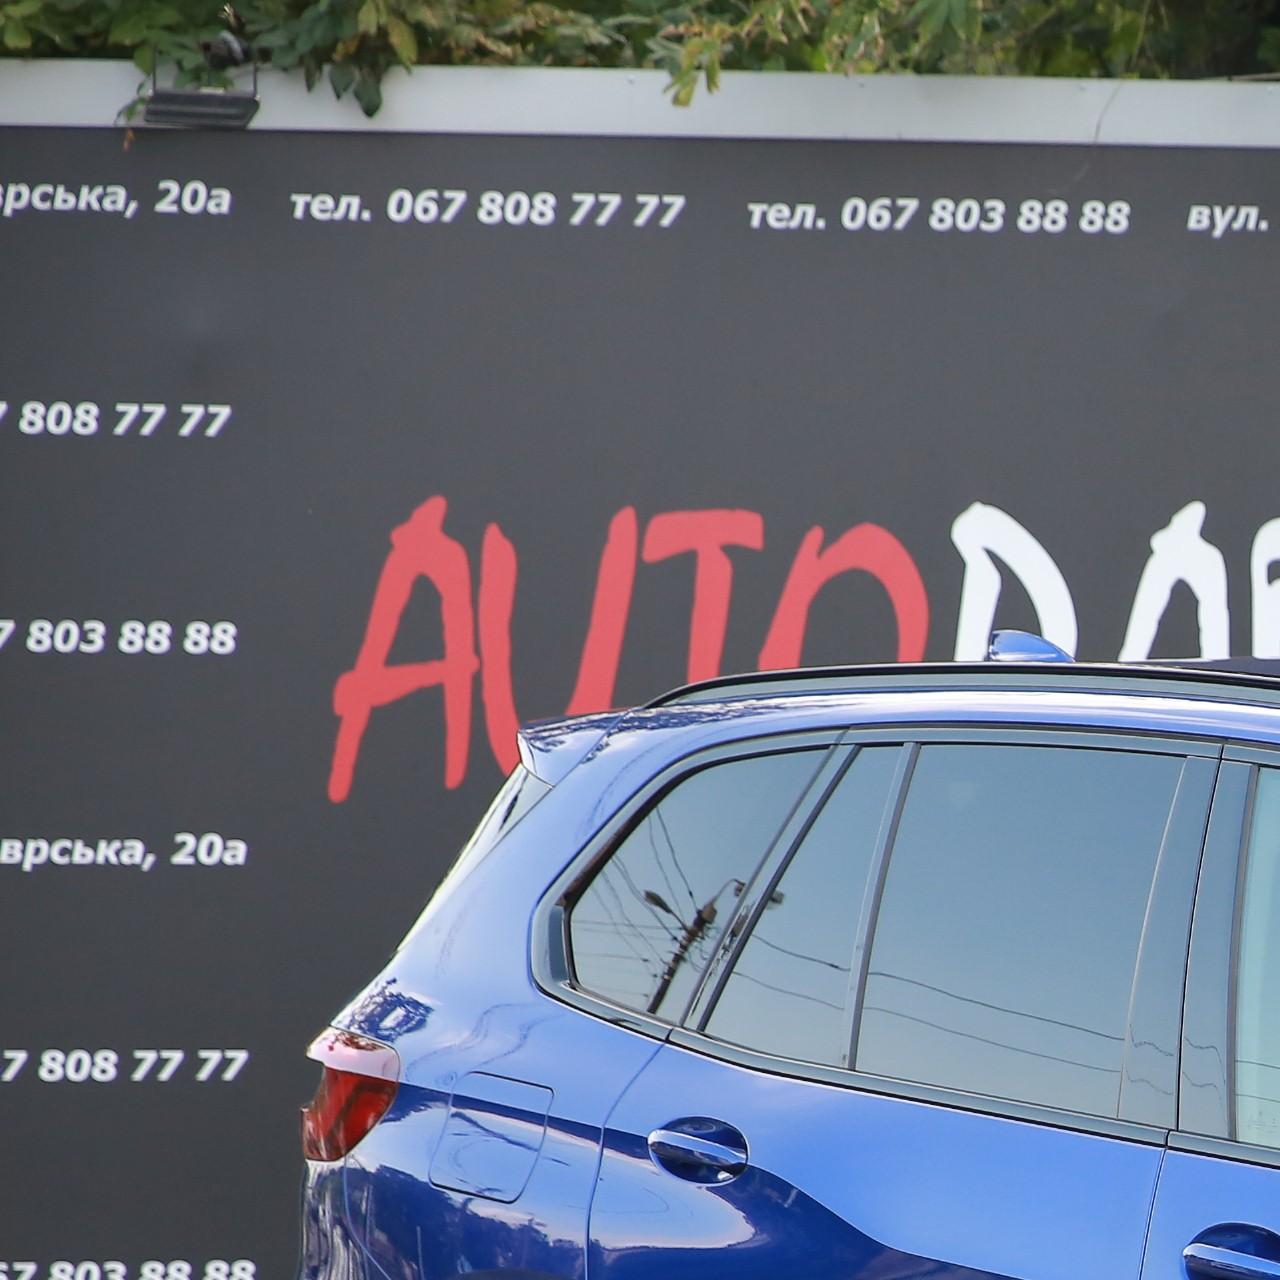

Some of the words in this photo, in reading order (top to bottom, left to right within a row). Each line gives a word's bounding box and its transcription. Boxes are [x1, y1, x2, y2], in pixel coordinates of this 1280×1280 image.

[0, 182, 139, 219] рська,
[154, 179, 232, 215] 20а
[290, 193, 371, 222] тел.
[387, 188, 468, 223] 067
[477, 190, 557, 226] 808
[569, 192, 622, 226] 77
[633, 194, 686, 228] 77
[747, 202, 826, 230] тел.
[841, 197, 918, 232] 067
[928, 198, 1006, 233] 803
[1016, 199, 1069, 233] 88
[1078, 200, 1131, 234] 88
[1187, 205, 1269, 239] вул.
[18, 400, 100, 436] 808
[113, 402, 167, 436] 77
[178, 403, 232, 438] 77
[26, 619, 107, 654] 803
[117, 620, 173, 655] 88
[183, 620, 238, 655] 88
[170, 832, 248, 866] 20а
[38, 1048, 119, 1083] 808
[131, 1049, 185, 1082] 77
[195, 1049, 249, 1082] 77
